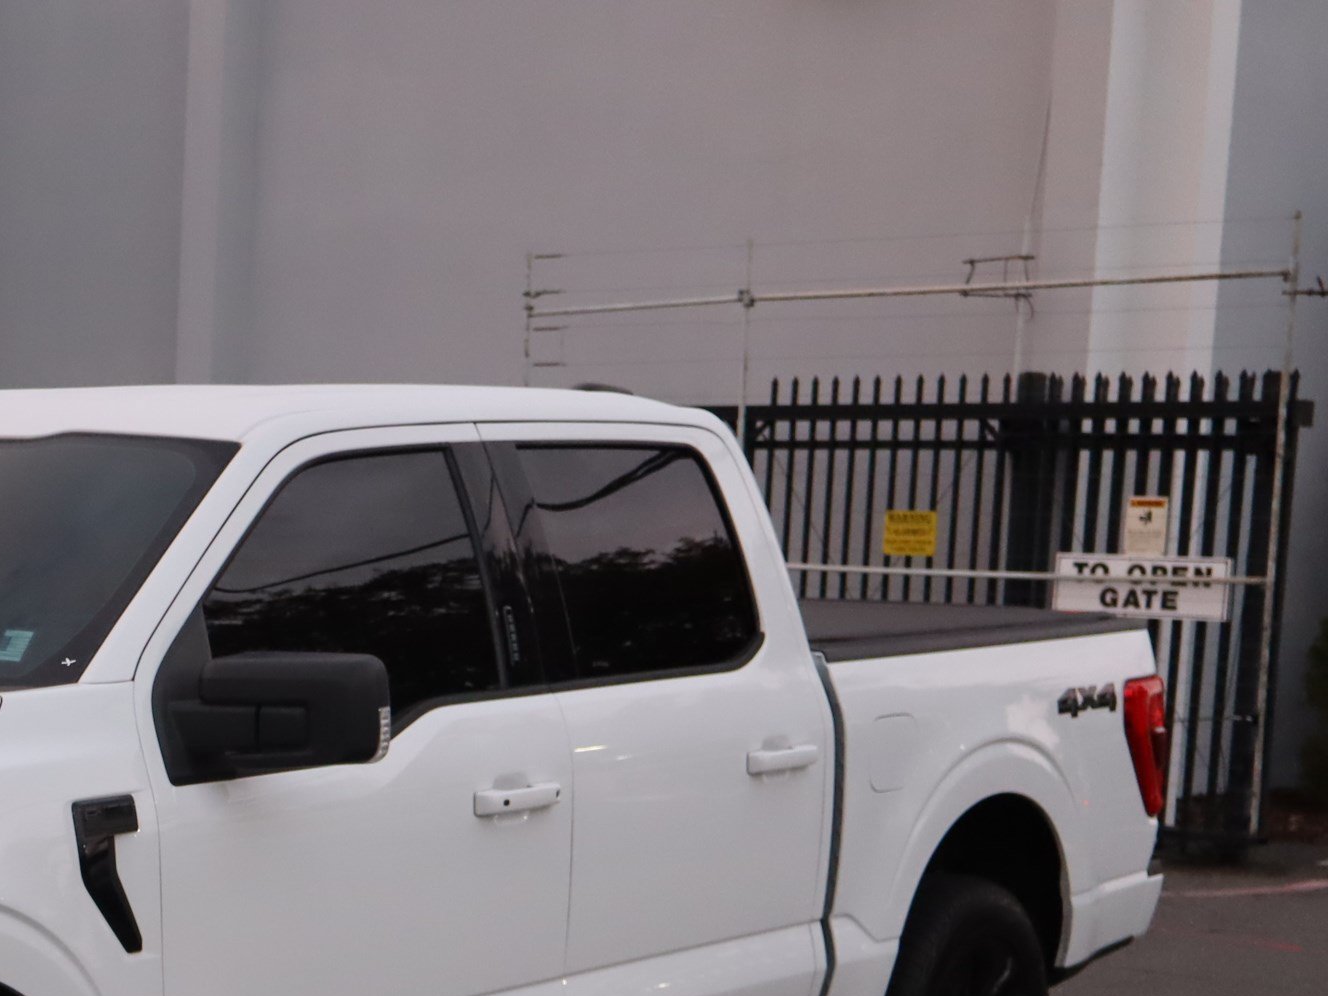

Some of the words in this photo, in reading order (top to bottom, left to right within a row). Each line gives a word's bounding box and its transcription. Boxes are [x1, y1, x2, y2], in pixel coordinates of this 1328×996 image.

[1074, 562, 1109, 583] TO
[1127, 564, 1213, 588] OPEN
[1100, 587, 1179, 610] GATE
